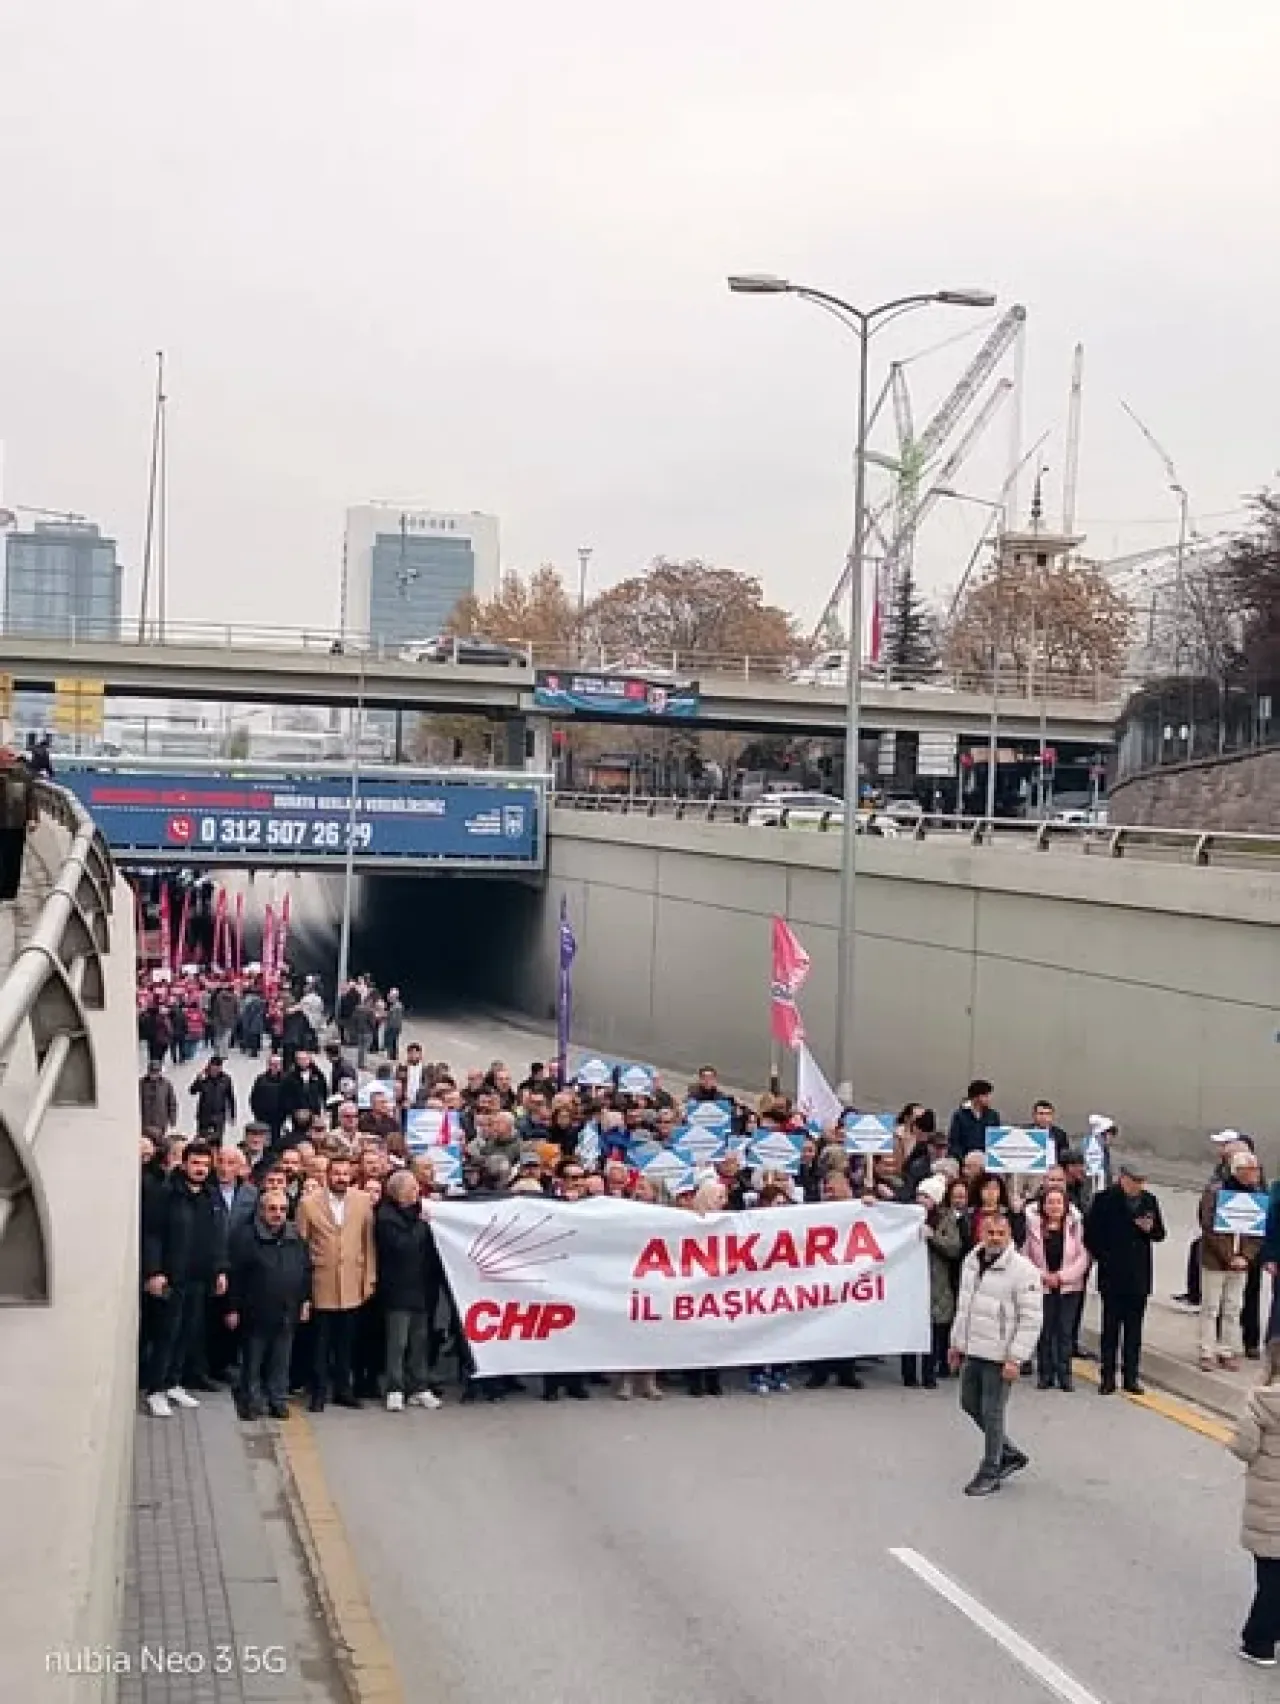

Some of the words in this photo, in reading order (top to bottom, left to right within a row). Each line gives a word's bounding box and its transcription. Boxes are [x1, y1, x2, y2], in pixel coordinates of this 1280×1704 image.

[201, 817, 216, 841] 0
[220, 817, 261, 843] 312
[266, 819, 307, 844] 507
[311, 822, 339, 846] 26
[632, 1220, 885, 1278] ANKARA
[629, 1287, 662, 1321] İL
[673, 1270, 885, 1322] BAŞKANLIĞI
[464, 1301, 576, 1342] CHP
